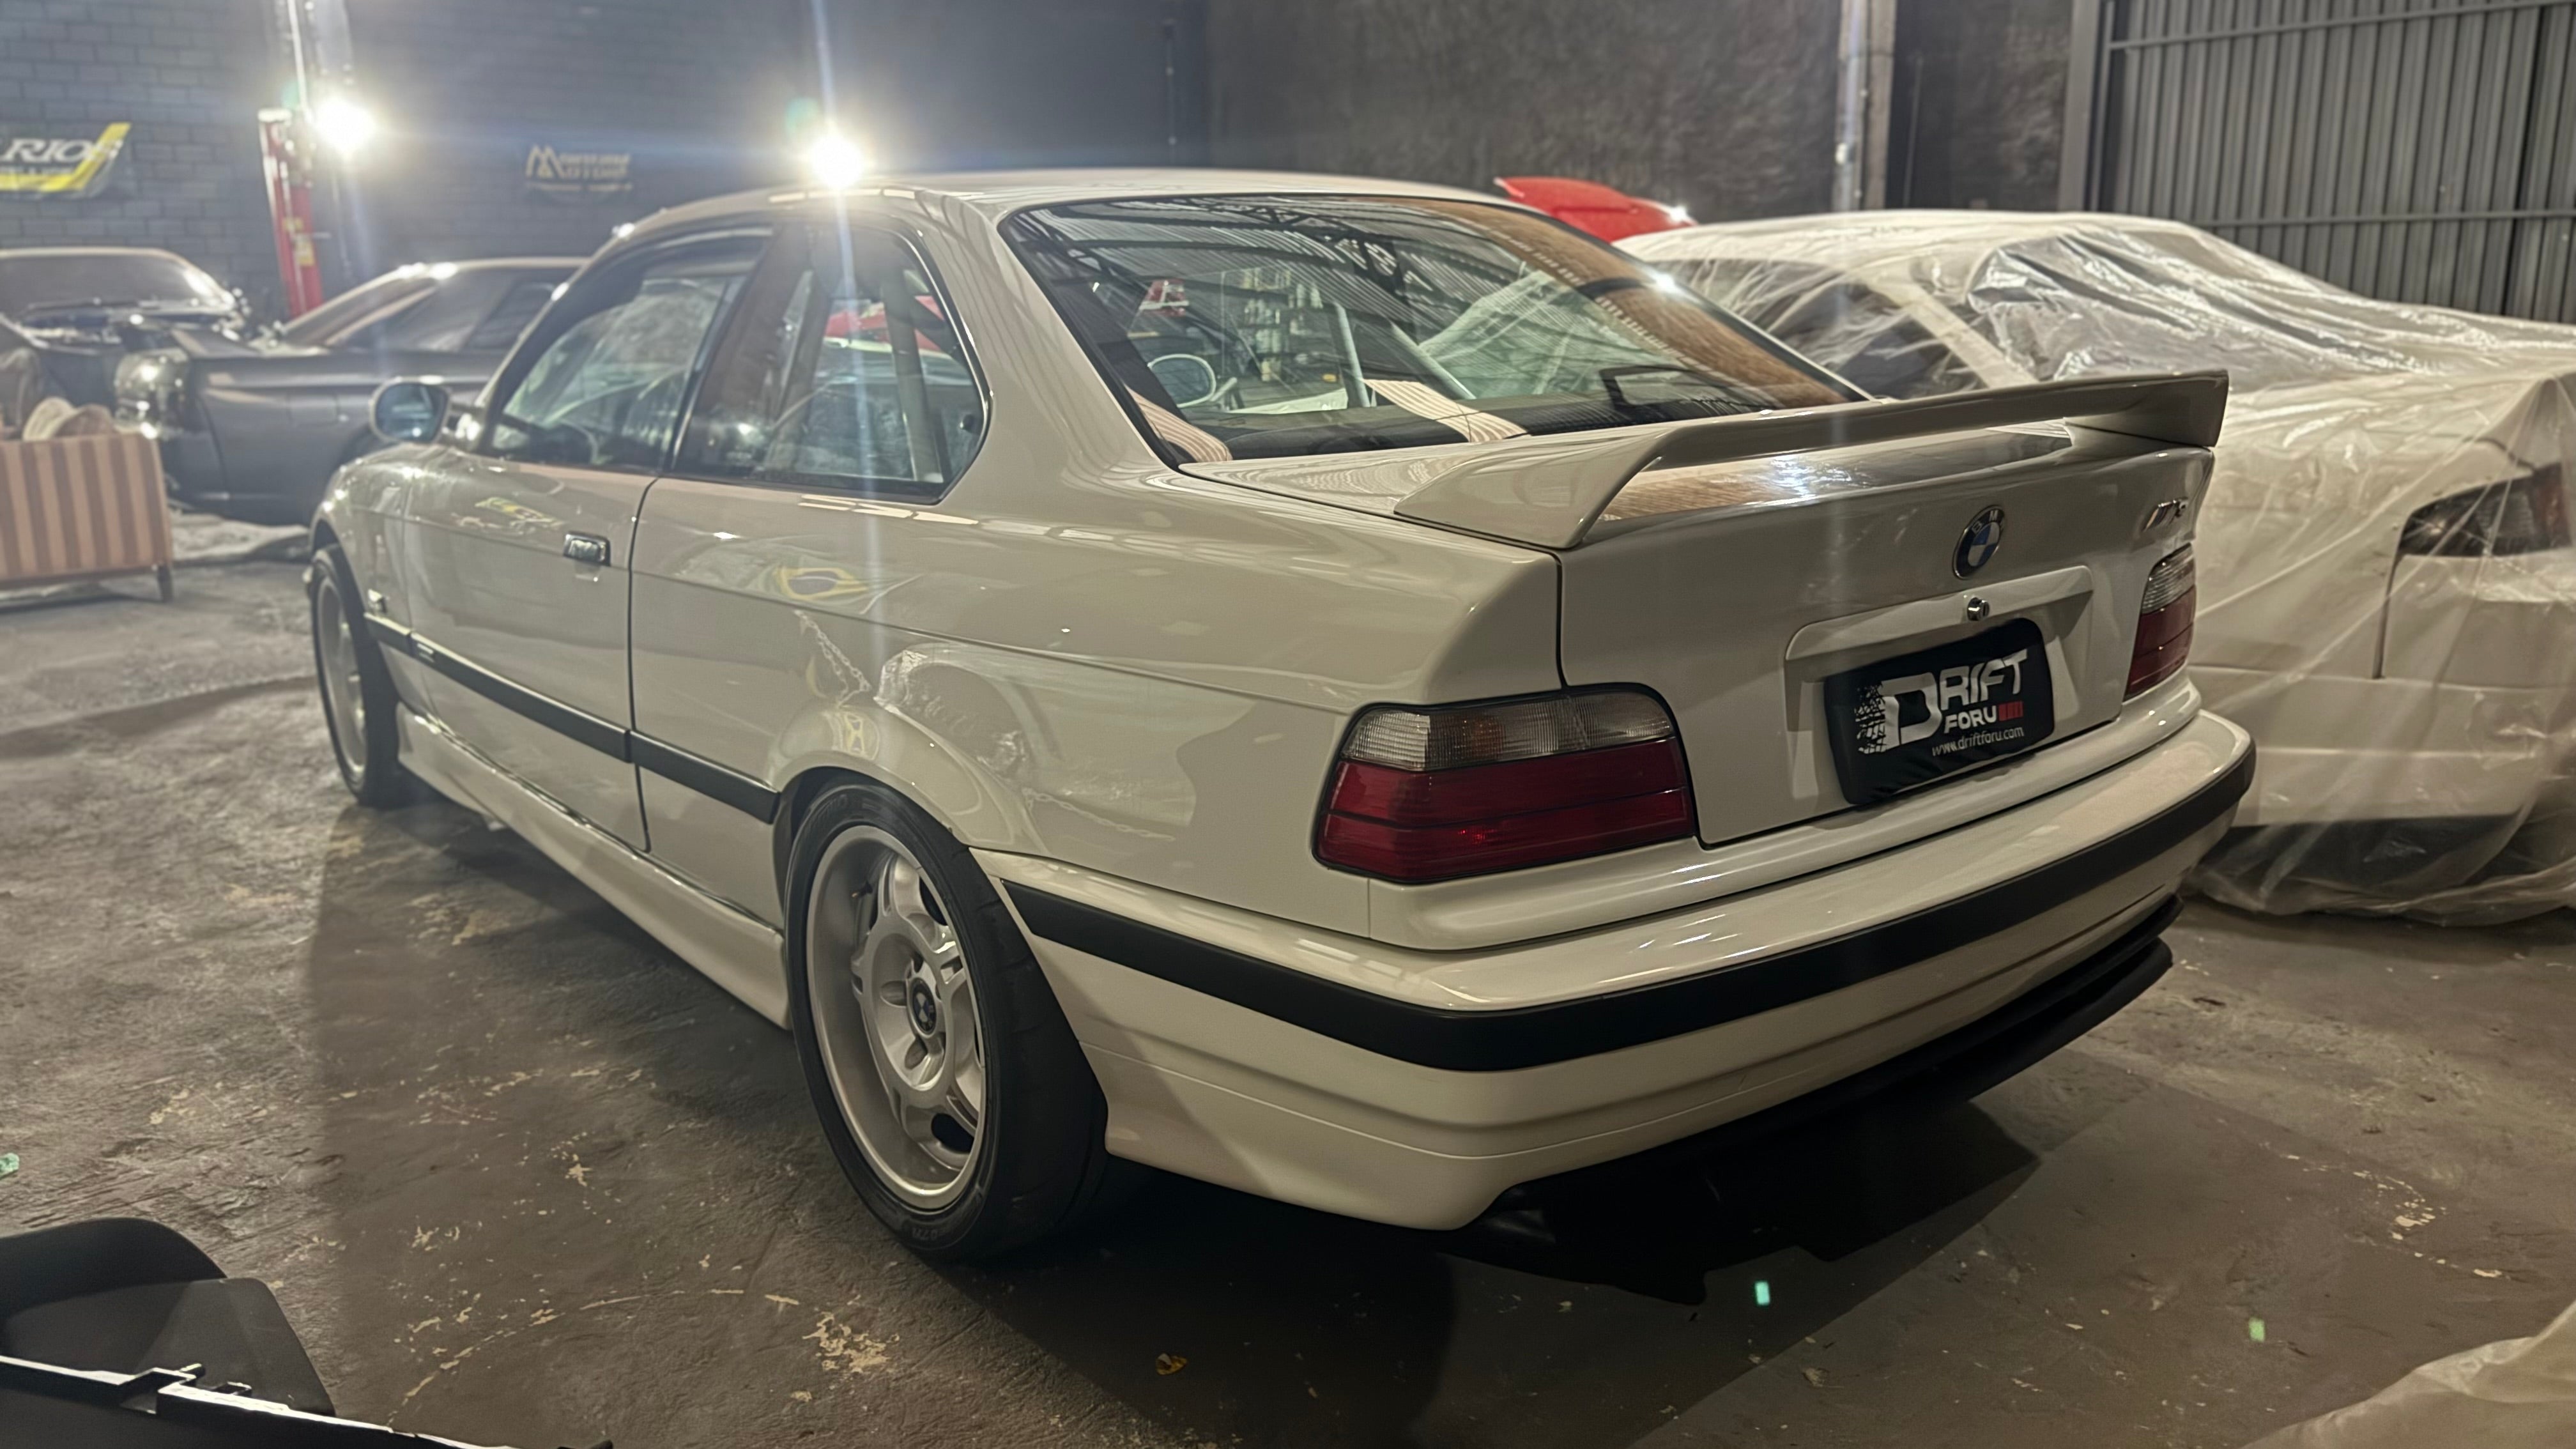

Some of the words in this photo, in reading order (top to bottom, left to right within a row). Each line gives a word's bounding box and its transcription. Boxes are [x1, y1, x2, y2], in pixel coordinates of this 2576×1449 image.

[1872, 648, 2028, 754] DRIFT
[1943, 705, 1997, 734] FORU
[1931, 726, 2025, 756] www.driftforu.com
